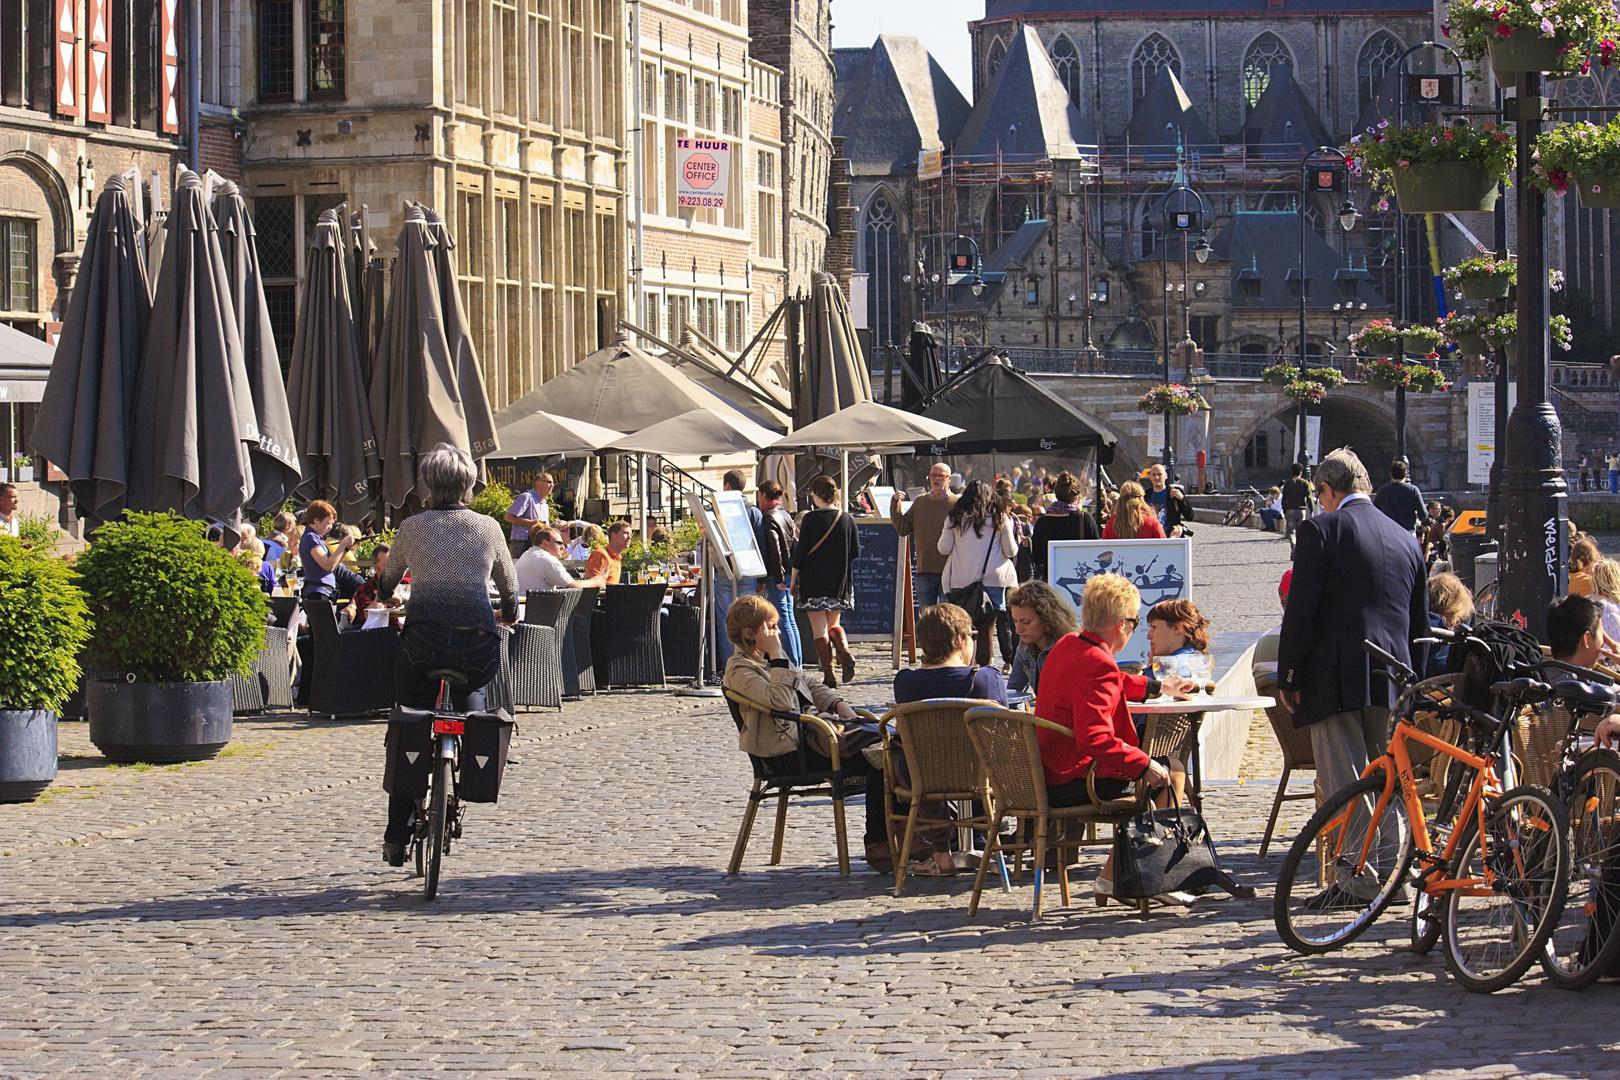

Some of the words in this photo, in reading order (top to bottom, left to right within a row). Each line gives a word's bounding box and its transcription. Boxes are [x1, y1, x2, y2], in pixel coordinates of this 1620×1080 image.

[677, 140, 690, 148] TE
[695, 141, 728, 150] HUUR
[686, 161, 716, 171] CENTER
[686, 171, 716, 181] OFFICE
